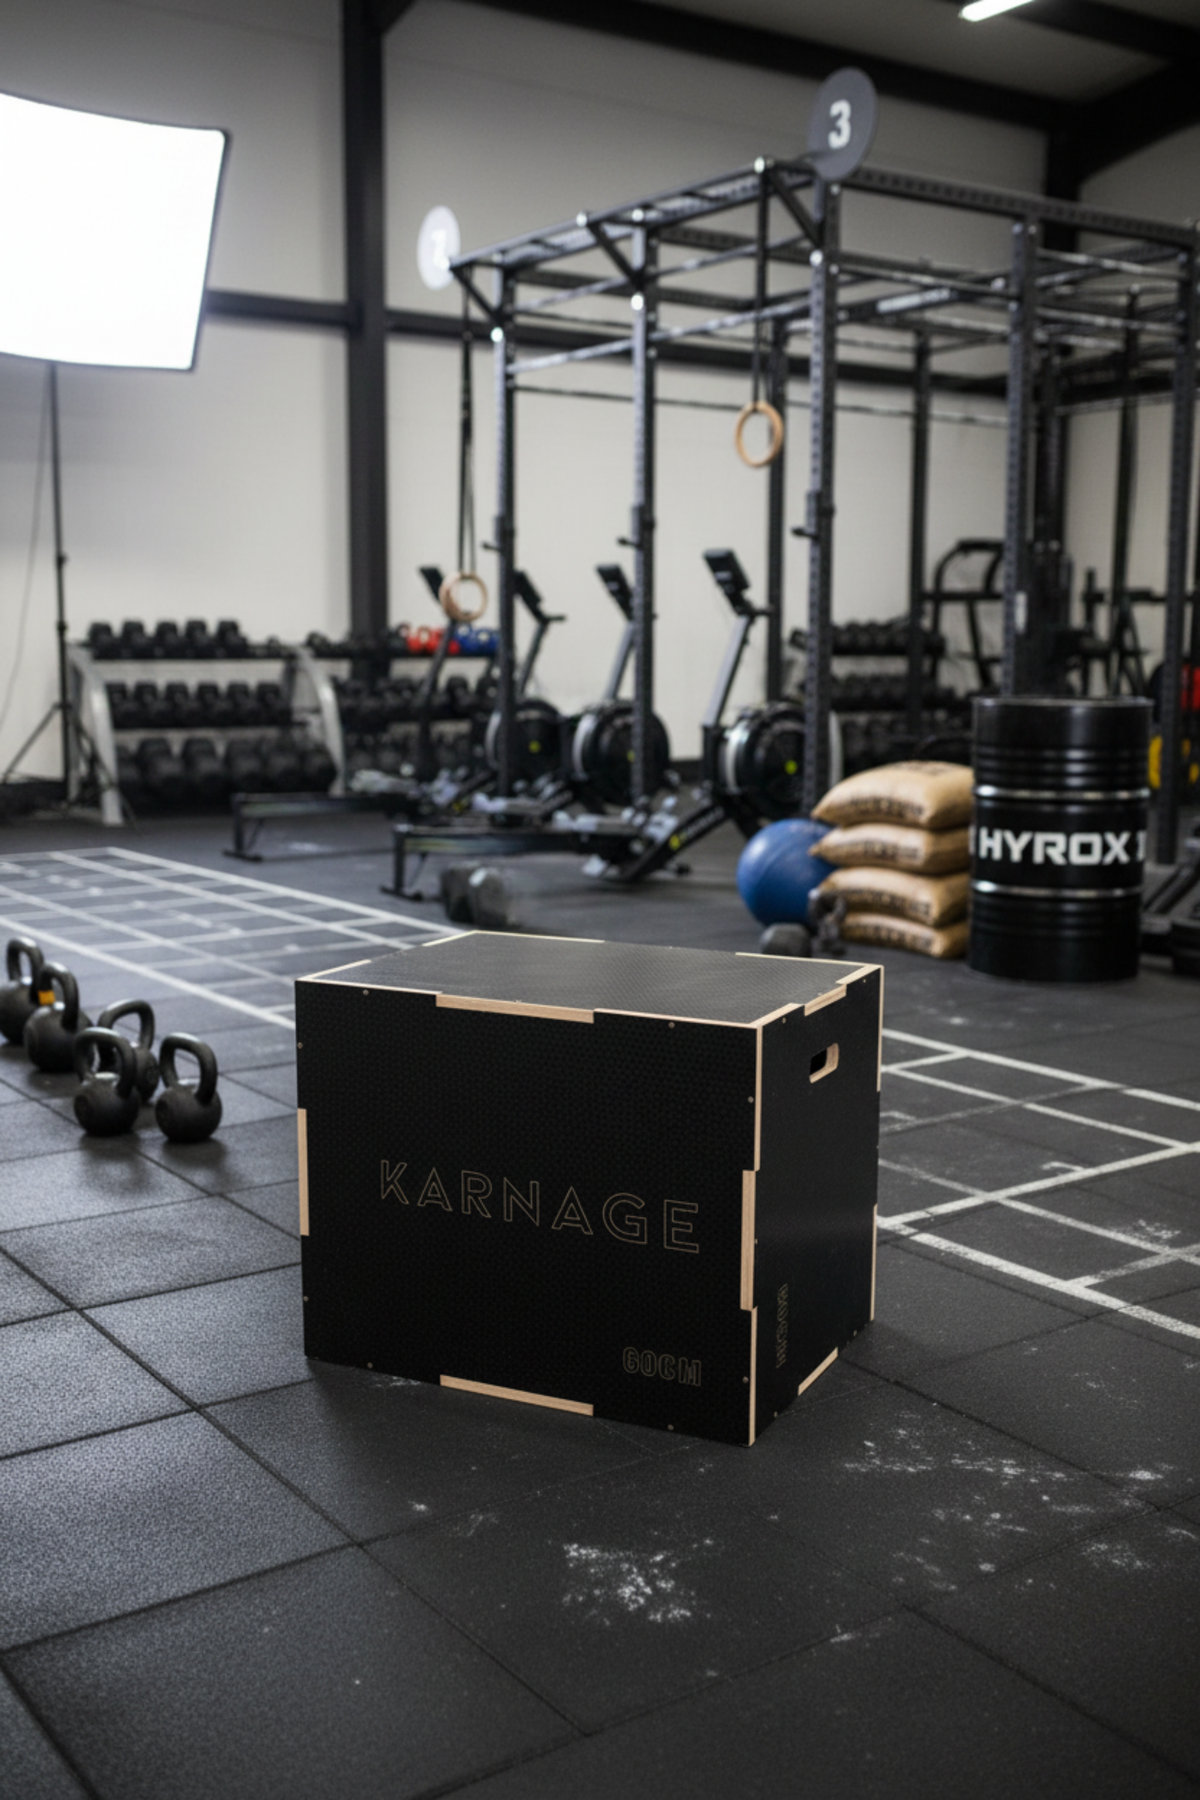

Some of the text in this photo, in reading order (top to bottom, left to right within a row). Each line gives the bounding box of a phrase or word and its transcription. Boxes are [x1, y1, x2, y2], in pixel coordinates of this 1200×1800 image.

[829, 100, 850, 148] 3
[978, 827, 1130, 865] HYROX
[380, 1159, 700, 1254] KARNAGE
[622, 1346, 702, 1387] 60CM
